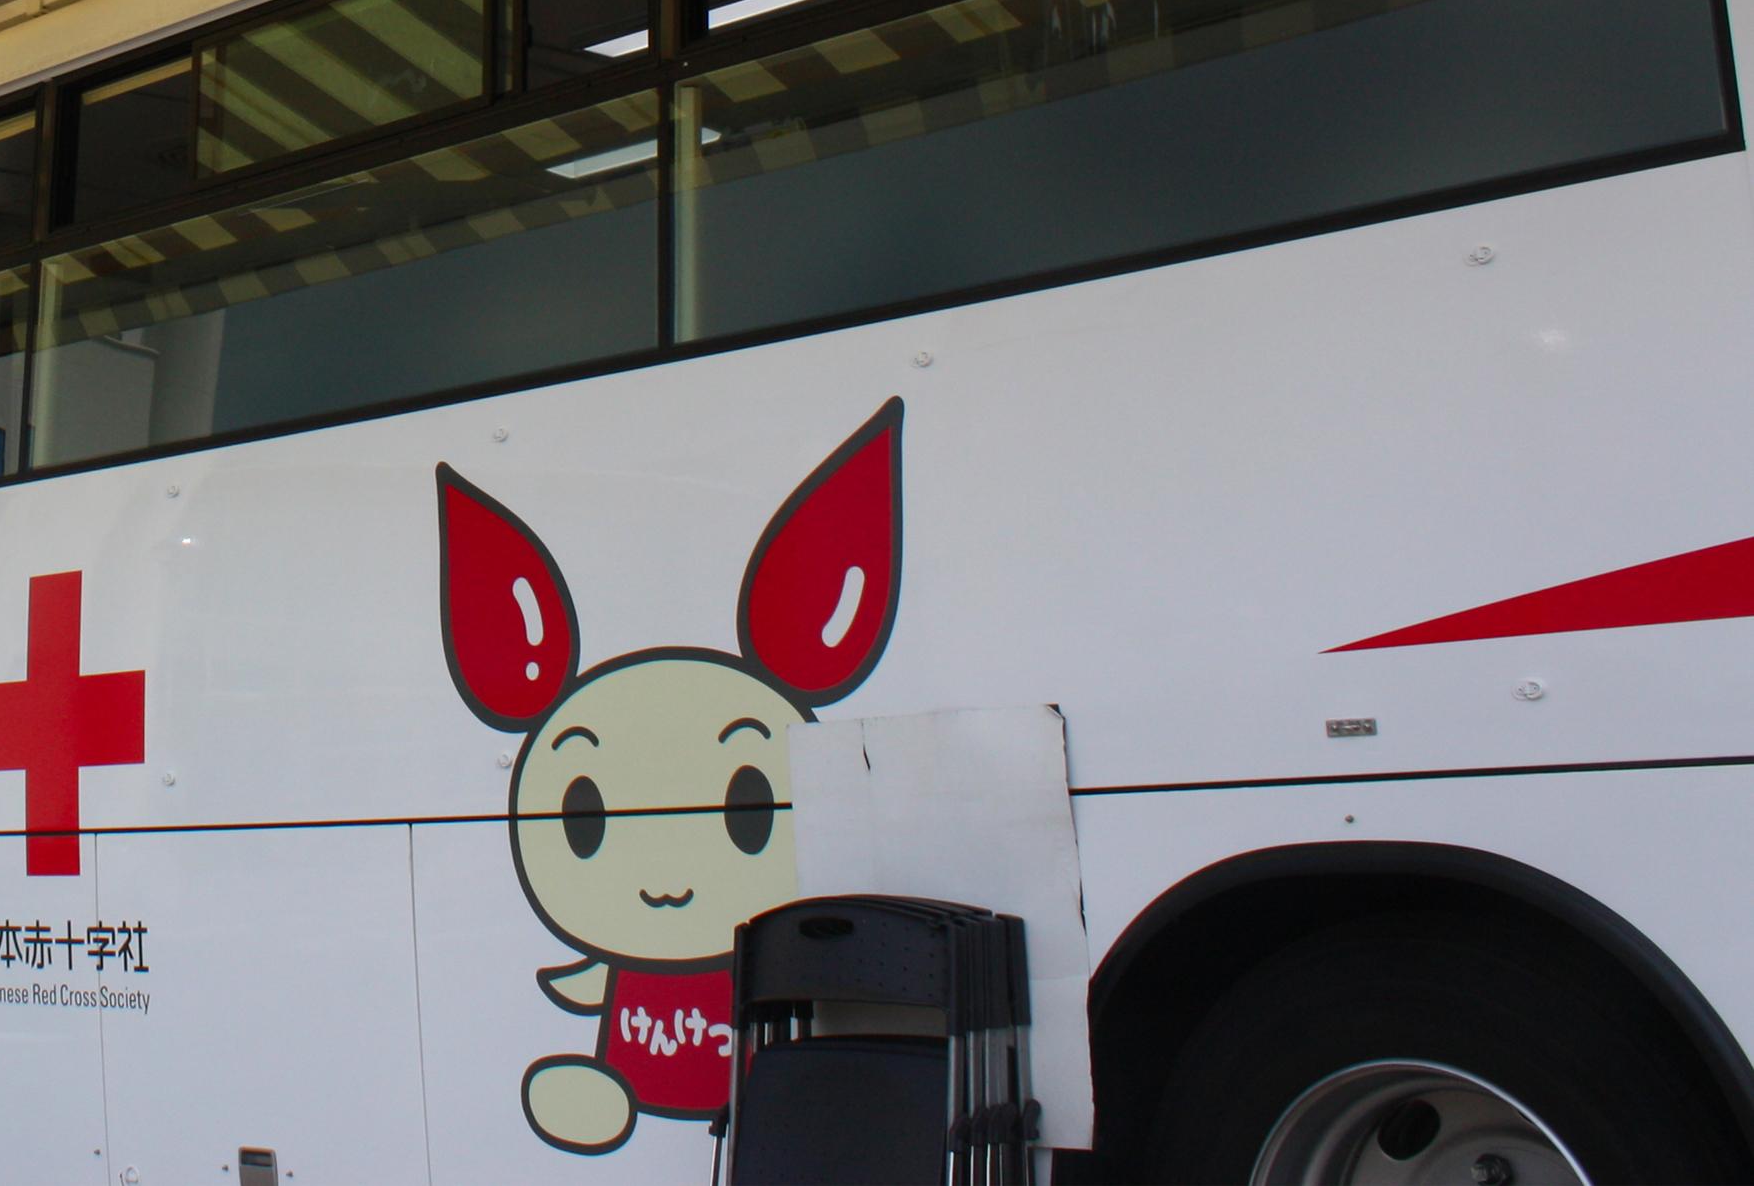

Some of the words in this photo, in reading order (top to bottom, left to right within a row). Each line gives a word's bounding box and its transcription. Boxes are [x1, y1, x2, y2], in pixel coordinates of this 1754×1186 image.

[32, 983, 57, 1006] Red
[60, 984, 97, 1008] Cross
[99, 985, 151, 1014] Society
[619, 1006, 733, 1057] けんけつ
